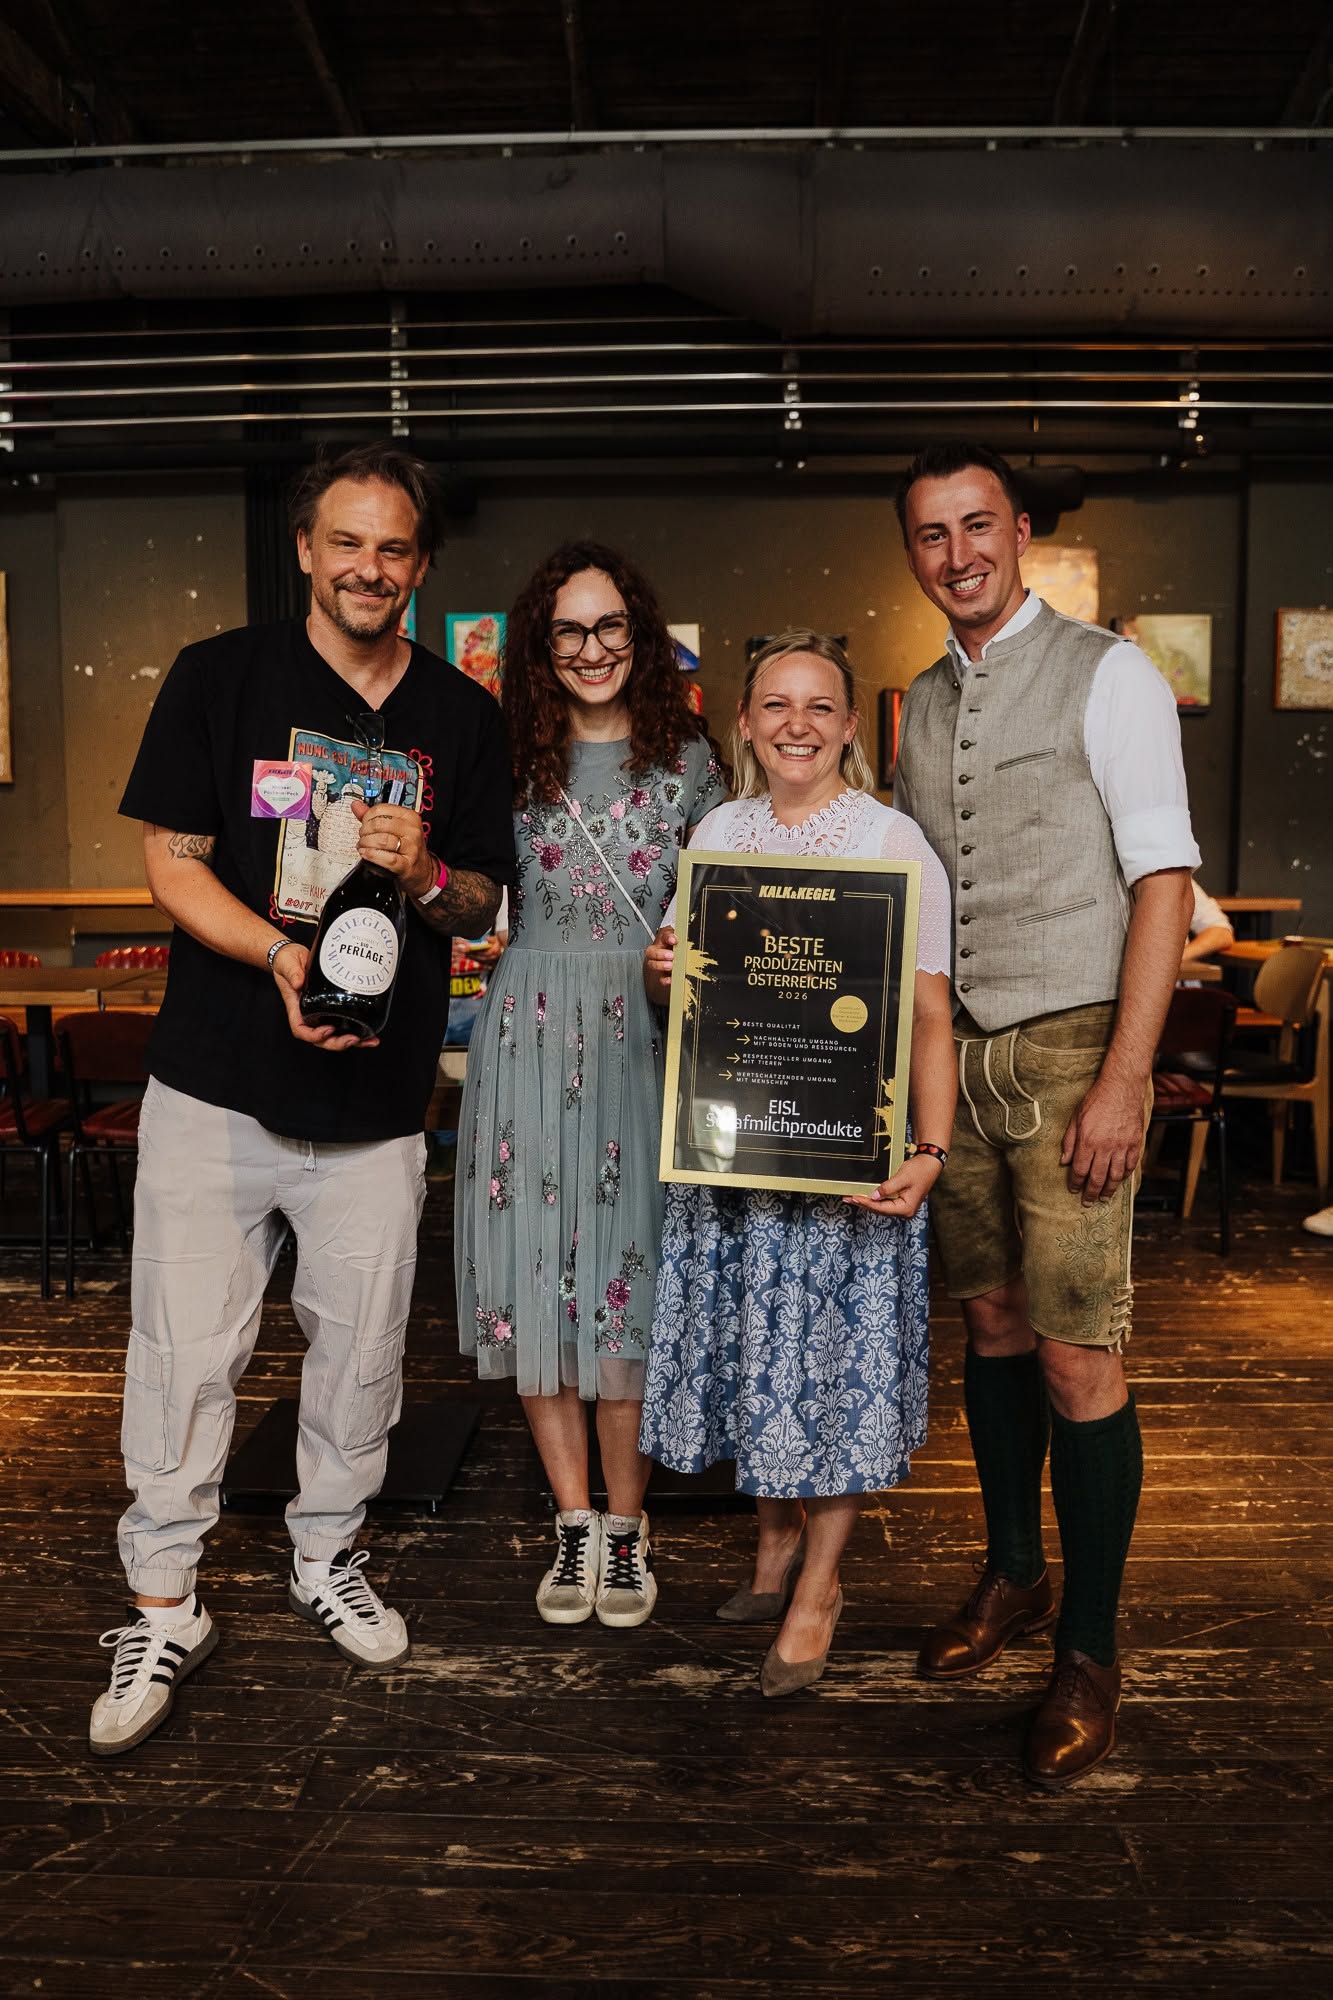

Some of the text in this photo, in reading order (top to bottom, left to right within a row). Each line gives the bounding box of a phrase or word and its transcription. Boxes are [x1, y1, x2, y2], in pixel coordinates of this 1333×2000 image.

[297, 743, 329, 760] NUNC
[758, 885, 836, 901] KALK&KEGEL
[284, 897, 313, 911] BOIT
[764, 935, 825, 956] BESTE
[339, 943, 384, 966] PERLAGE
[744, 955, 843, 974] PRODUZENTEN
[747, 968, 837, 990] ÖSTERREICHS
[778, 991, 808, 1000] 2026
[766, 1022, 801, 1030] QUALITÄT
[753, 1035, 839, 1046] NACHHALTIGER UMGANG
[811, 1044, 858, 1052] RESSOURCEN
[742, 1053, 800, 1062] RESPEKTVOLLER
[736, 1072, 805, 1081] WERTSCHÄTZENDER
[768, 1099, 801, 1116] EISL
[705, 1112, 863, 1138] Safmilchprodukte
